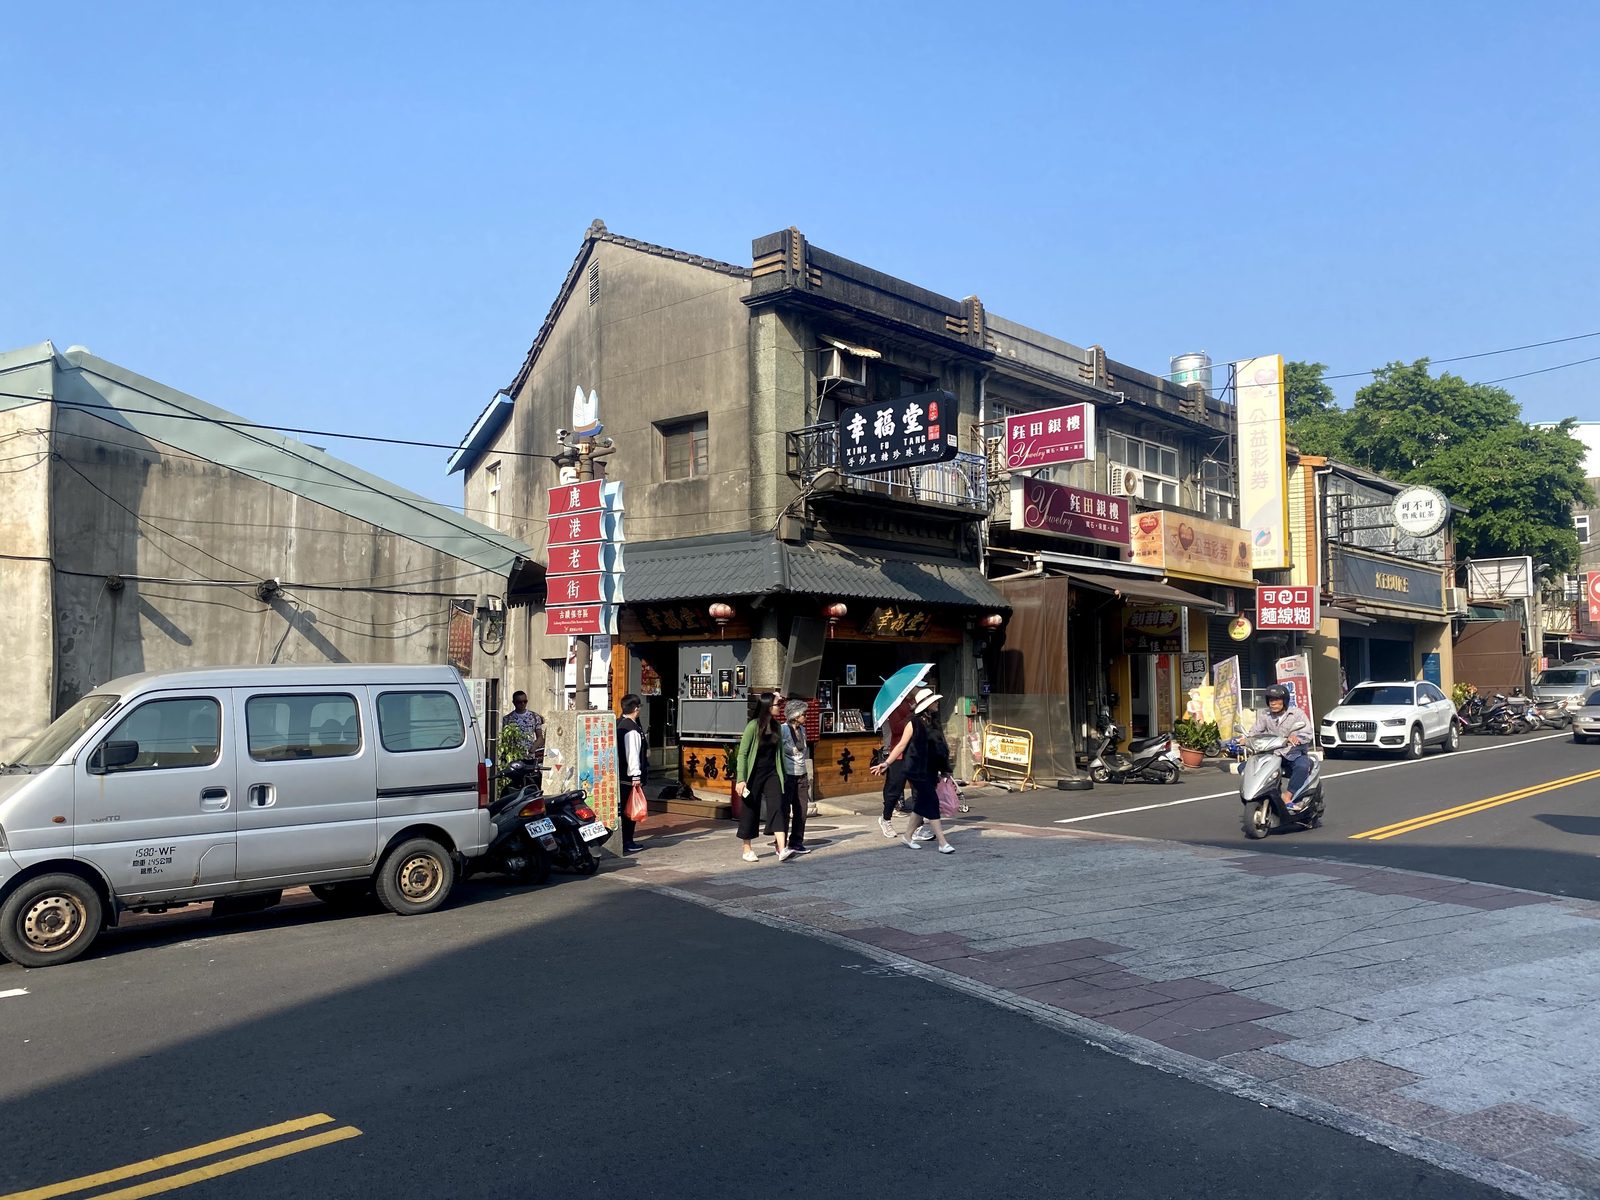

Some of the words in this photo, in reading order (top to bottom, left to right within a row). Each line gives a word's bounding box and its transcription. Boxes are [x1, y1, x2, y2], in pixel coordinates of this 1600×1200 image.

[846, 402, 924, 445] 幸福堂
[846, 446, 868, 456] XING
[880, 442, 890, 450] FU
[903, 435, 926, 446] TANG
[847, 443, 940, 467] 手炒黑糖珍珠鮮奶
[1249, 408, 1269, 489] 公益彩券
[1402, 499, 1434, 512] 可不可
[566, 486, 583, 600] 鹿港老街
[1375, 572, 1409, 592] KEBUKE
[877, 610, 925, 632] 幸福堂
[1261, 607, 1311, 625] 麵線糊
[136, 846, 176, 857] 1580-WF
